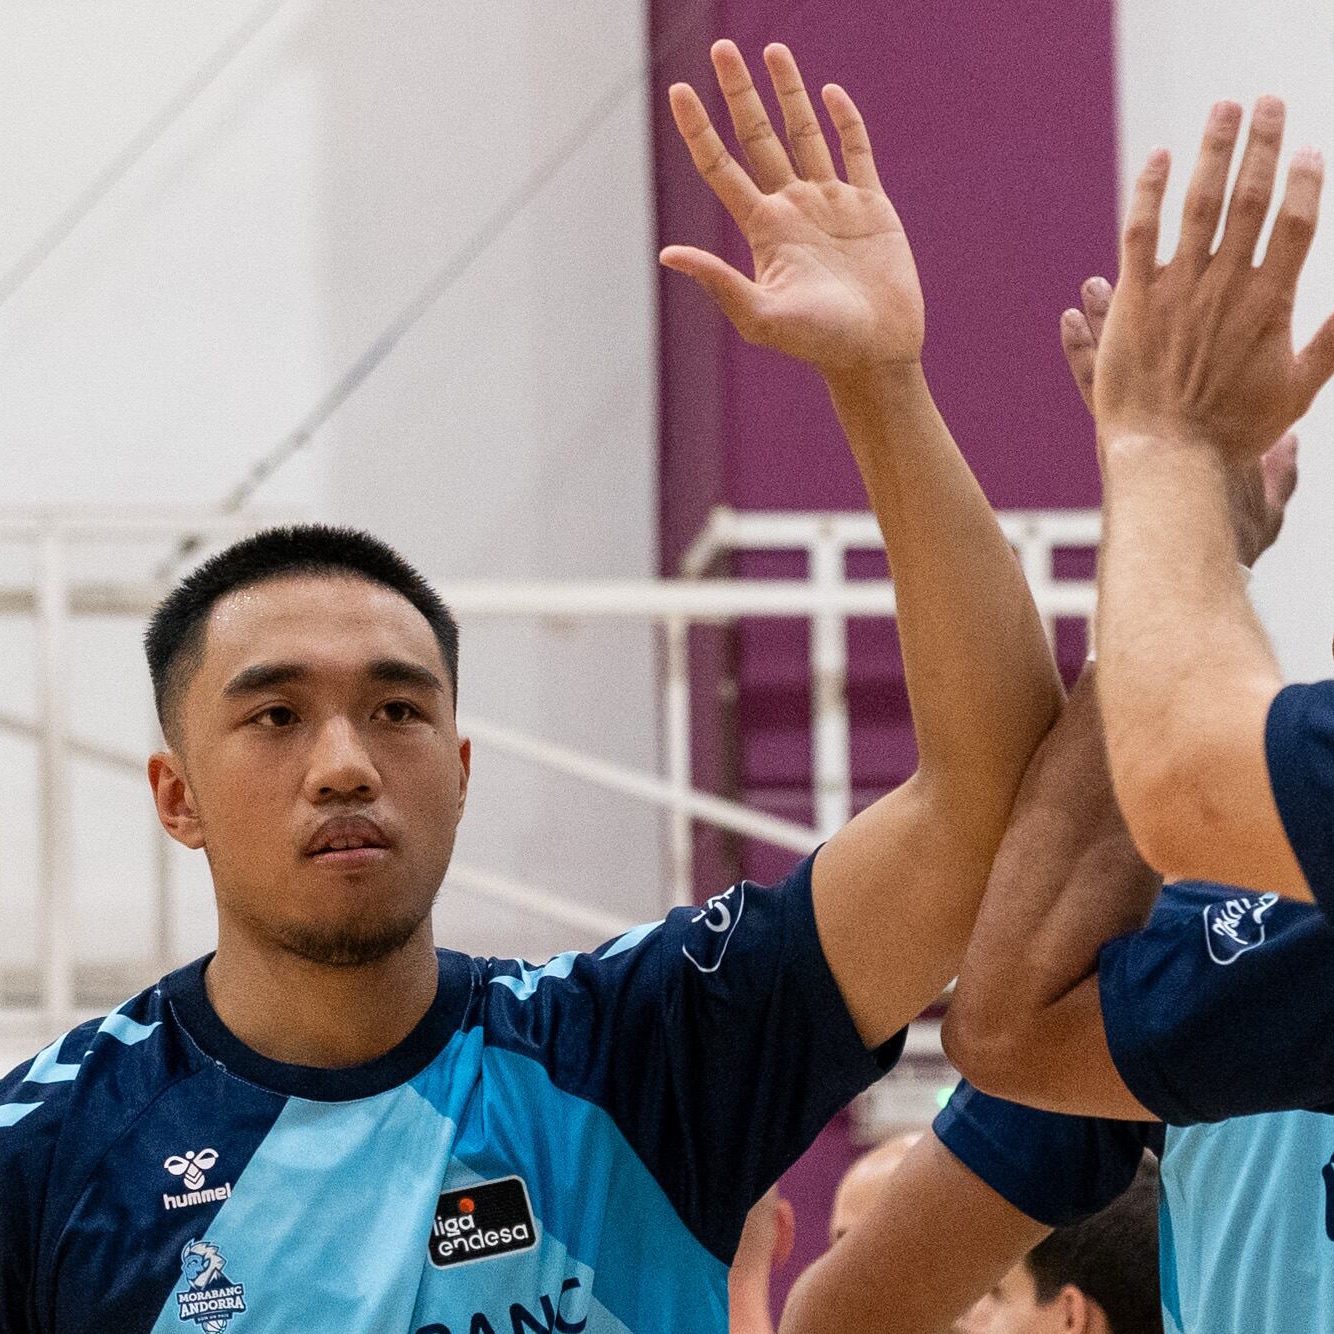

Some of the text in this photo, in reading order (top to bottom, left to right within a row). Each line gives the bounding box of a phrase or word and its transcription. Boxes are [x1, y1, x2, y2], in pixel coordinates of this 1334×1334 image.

[162, 1182, 232, 1209] hummel
[433, 1214, 475, 1237] liga
[438, 1223, 529, 1256] endesa
[178, 1285, 243, 1303] MORABANC
[180, 1295, 245, 1318] ANDORRA
